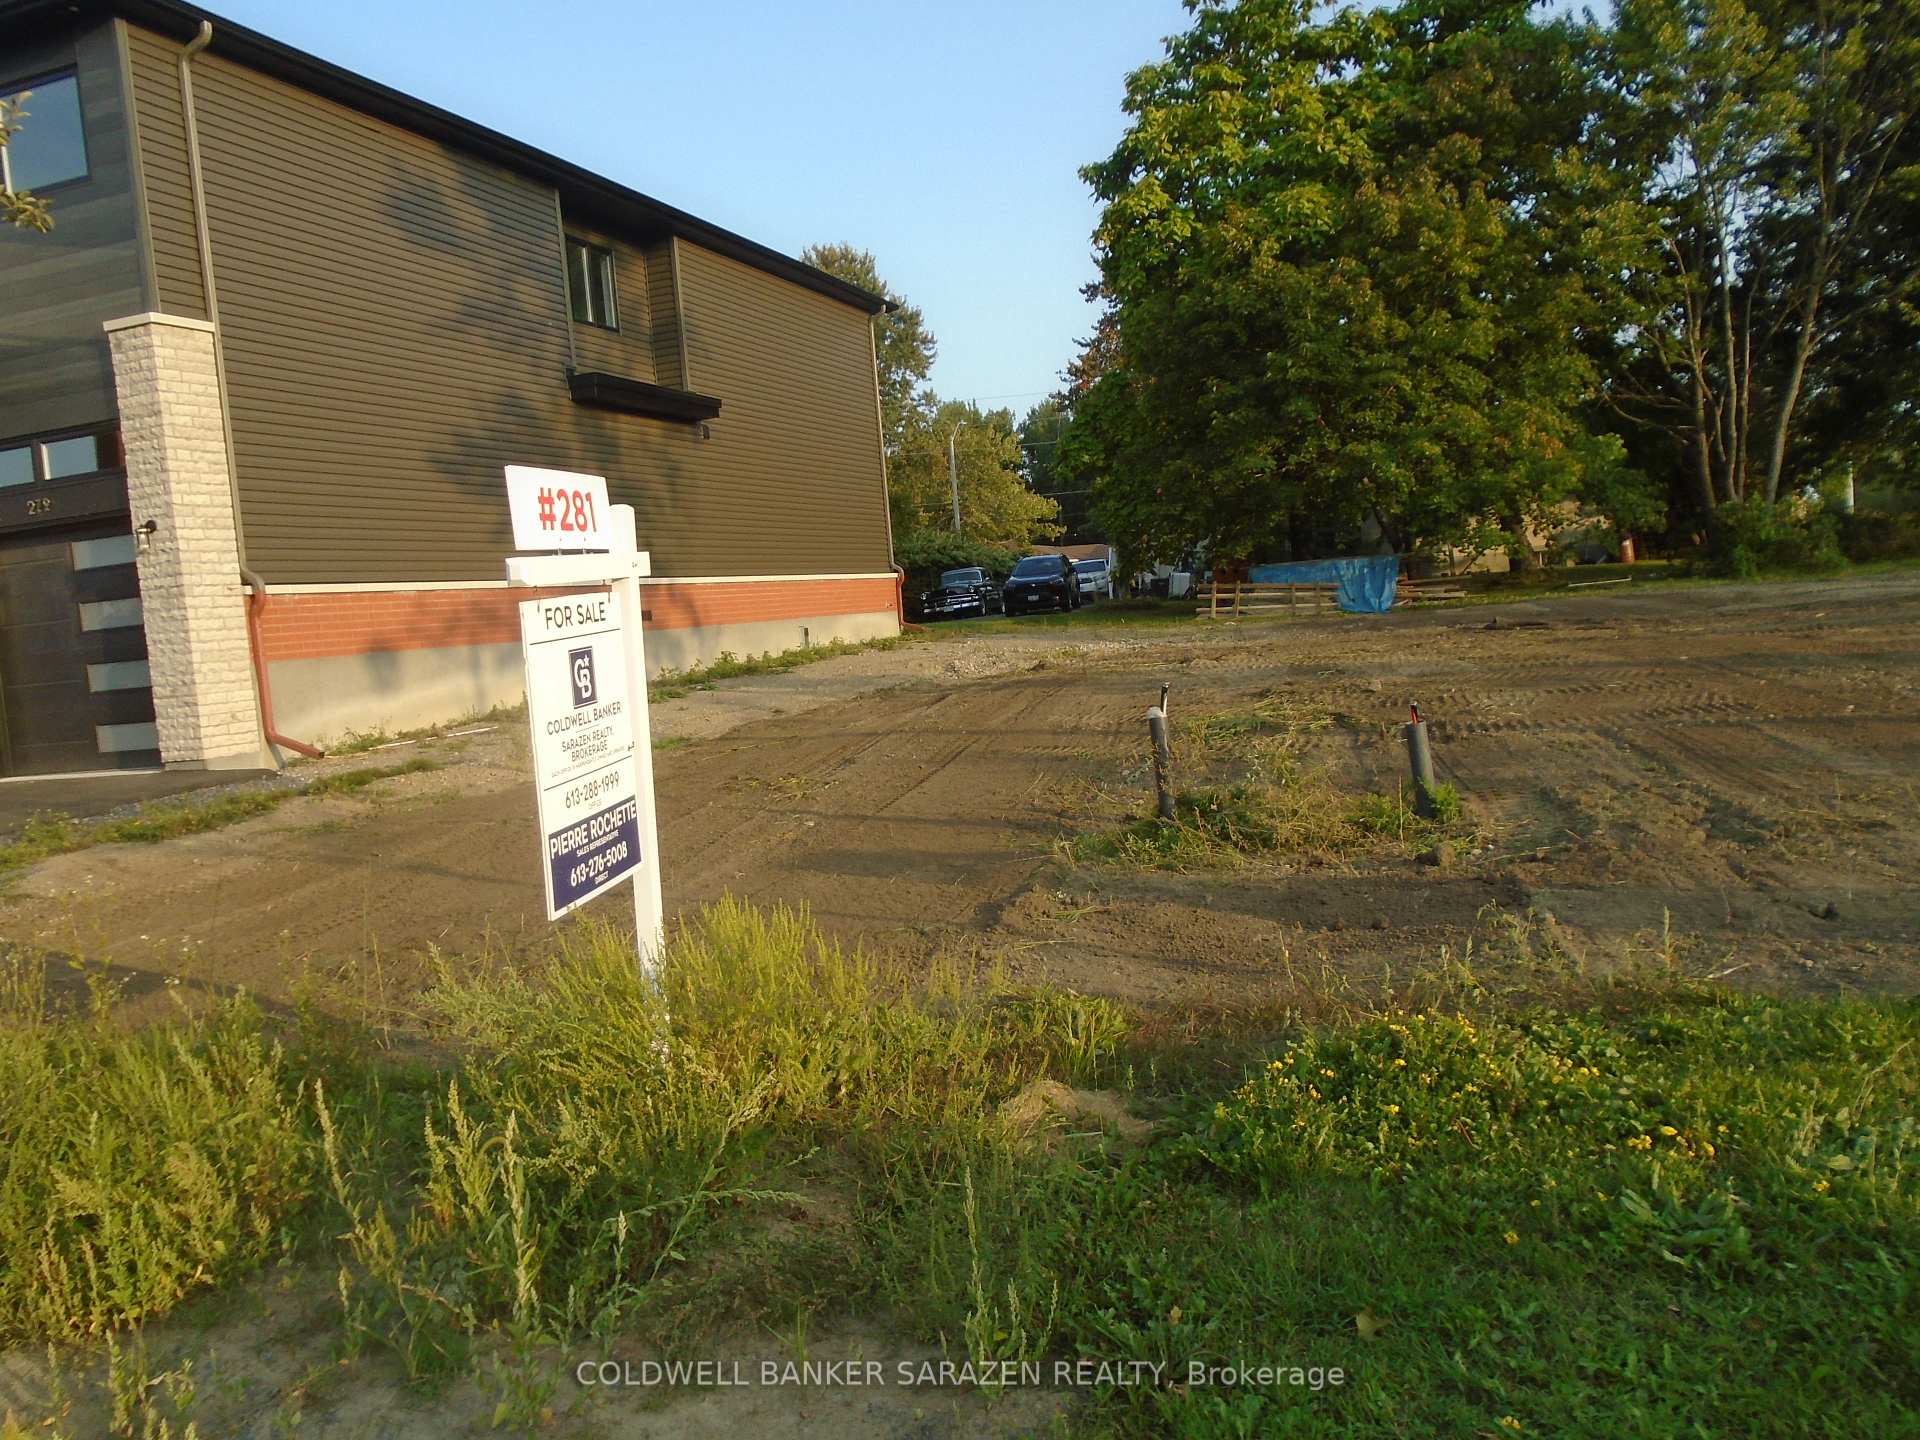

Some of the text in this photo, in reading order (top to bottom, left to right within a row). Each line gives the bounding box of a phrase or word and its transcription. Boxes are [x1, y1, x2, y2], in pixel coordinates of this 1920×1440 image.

[538, 487, 597, 533] #281
[545, 601, 607, 630] FOR SALE
[547, 701, 622, 736] COLDWELL BANKER
[562, 733, 591, 752] SARAZEN
[571, 740, 608, 762] BROKERAGE
[566, 771, 620, 809] 613-288-1999
[551, 800, 638, 860] PIERRE ROCHETTE
[570, 841, 628, 887] 613-276-5008
